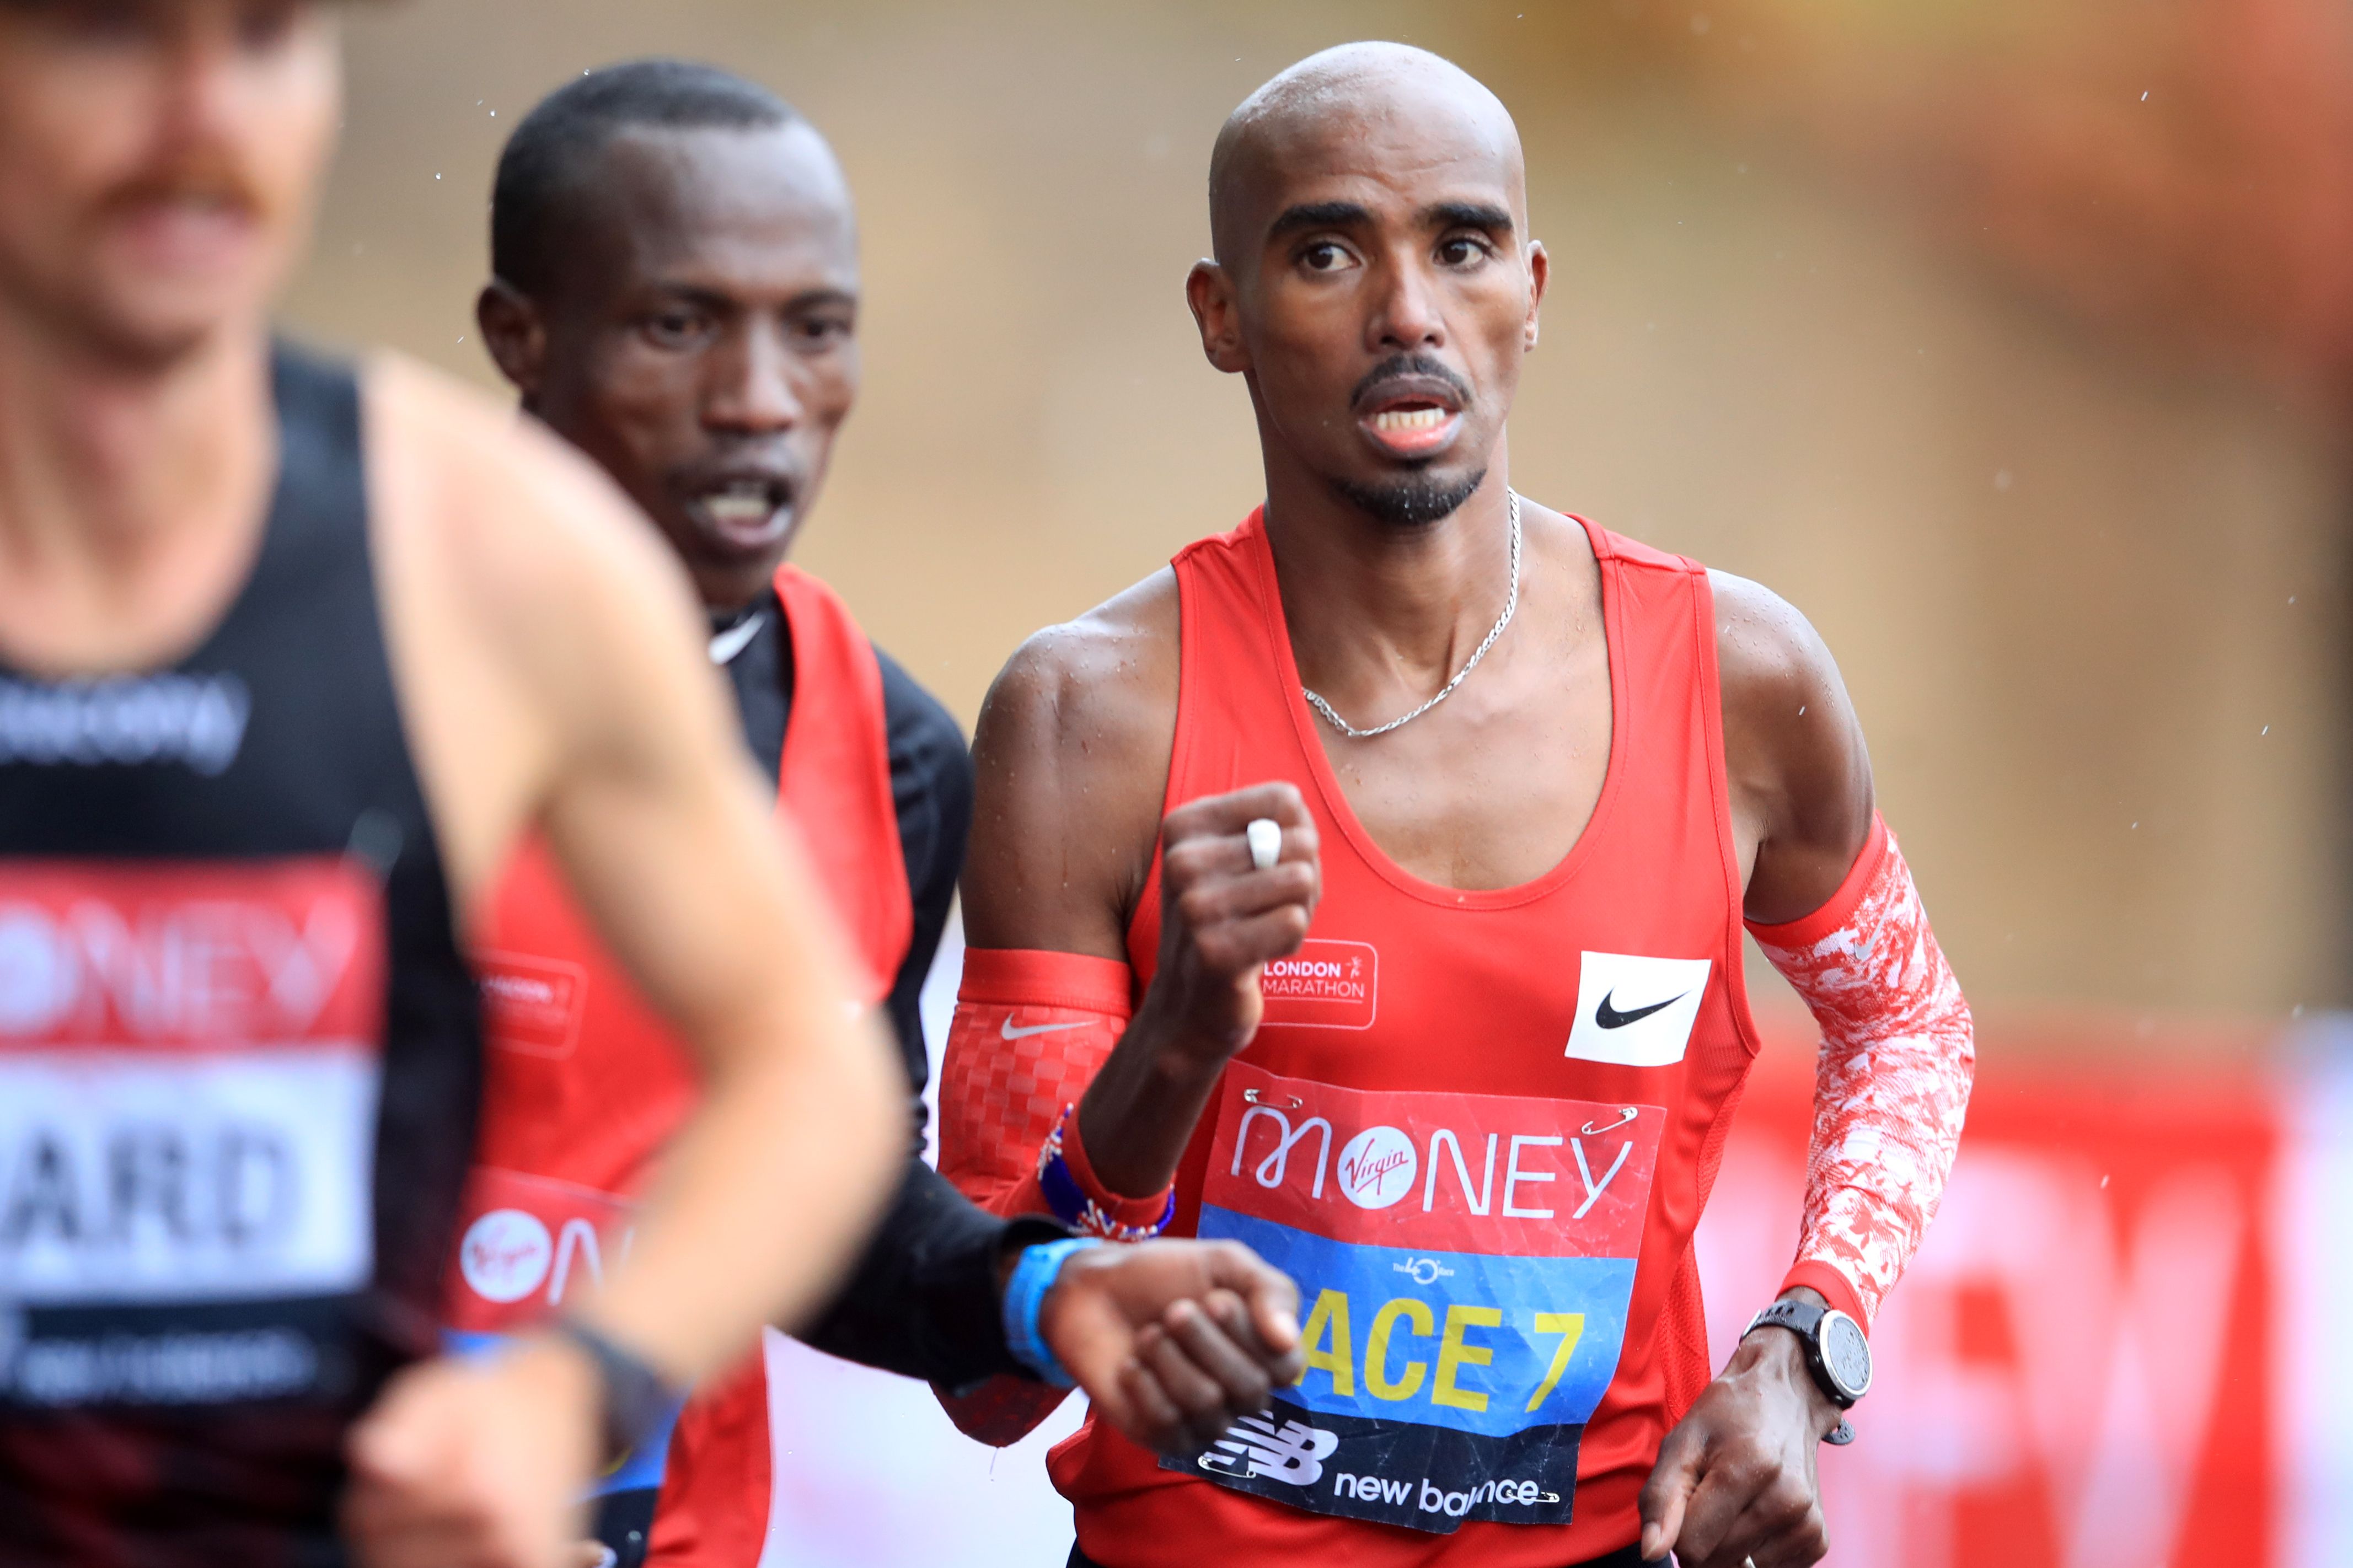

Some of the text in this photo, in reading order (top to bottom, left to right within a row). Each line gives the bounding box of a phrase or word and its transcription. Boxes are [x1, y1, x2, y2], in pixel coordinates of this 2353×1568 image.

[1263, 961, 1341, 977] LONDON
[1263, 979, 1365, 998] MARATHON
[1231, 1106, 1633, 1219] MONEY
[1344, 1138, 1408, 1195] Virgin
[1291, 1288, 1585, 1413] ACE 7
[1334, 1473, 1539, 1517] new balnce
